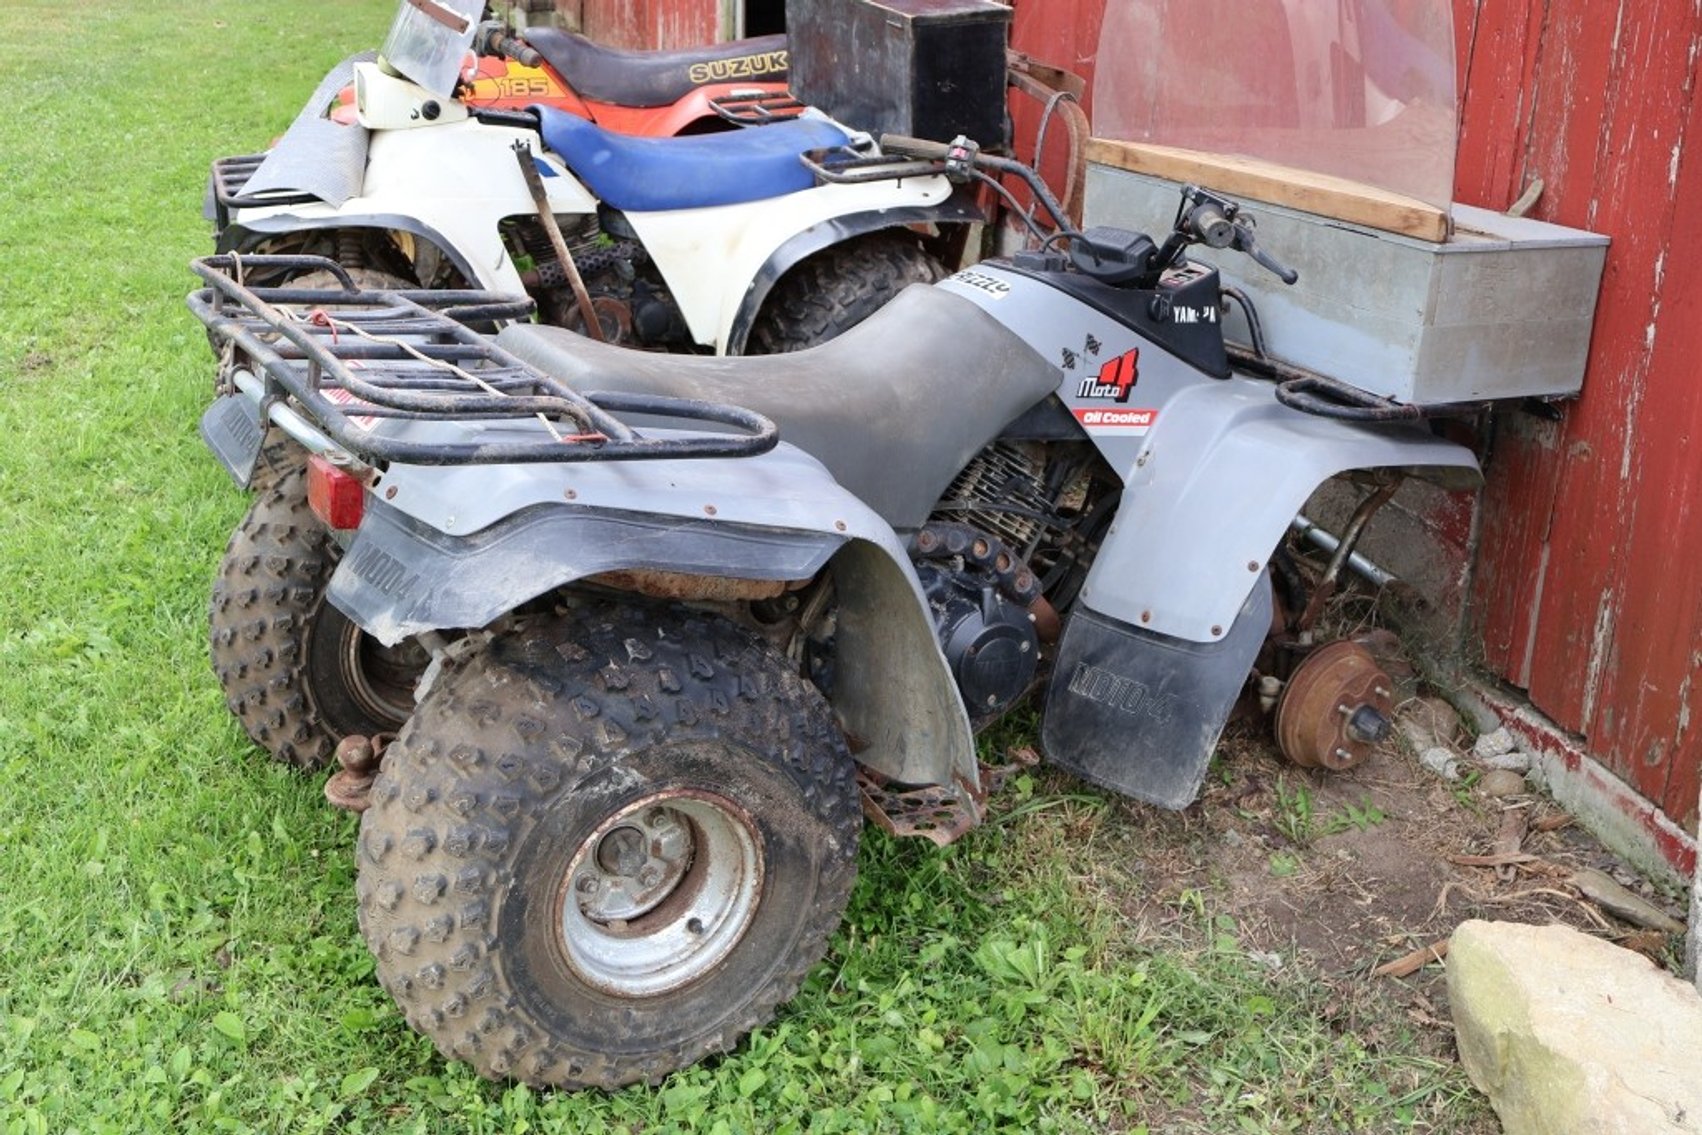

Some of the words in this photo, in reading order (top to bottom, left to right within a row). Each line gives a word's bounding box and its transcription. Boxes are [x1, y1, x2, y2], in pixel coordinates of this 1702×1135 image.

[690, 51, 788, 84] SUZUK
[499, 77, 549, 98] 185
[1077, 376, 1121, 398] Moto
[1100, 347, 1139, 403] 4
[1083, 411, 1102, 424] Oil
[1102, 412, 1151, 424] Cooled
